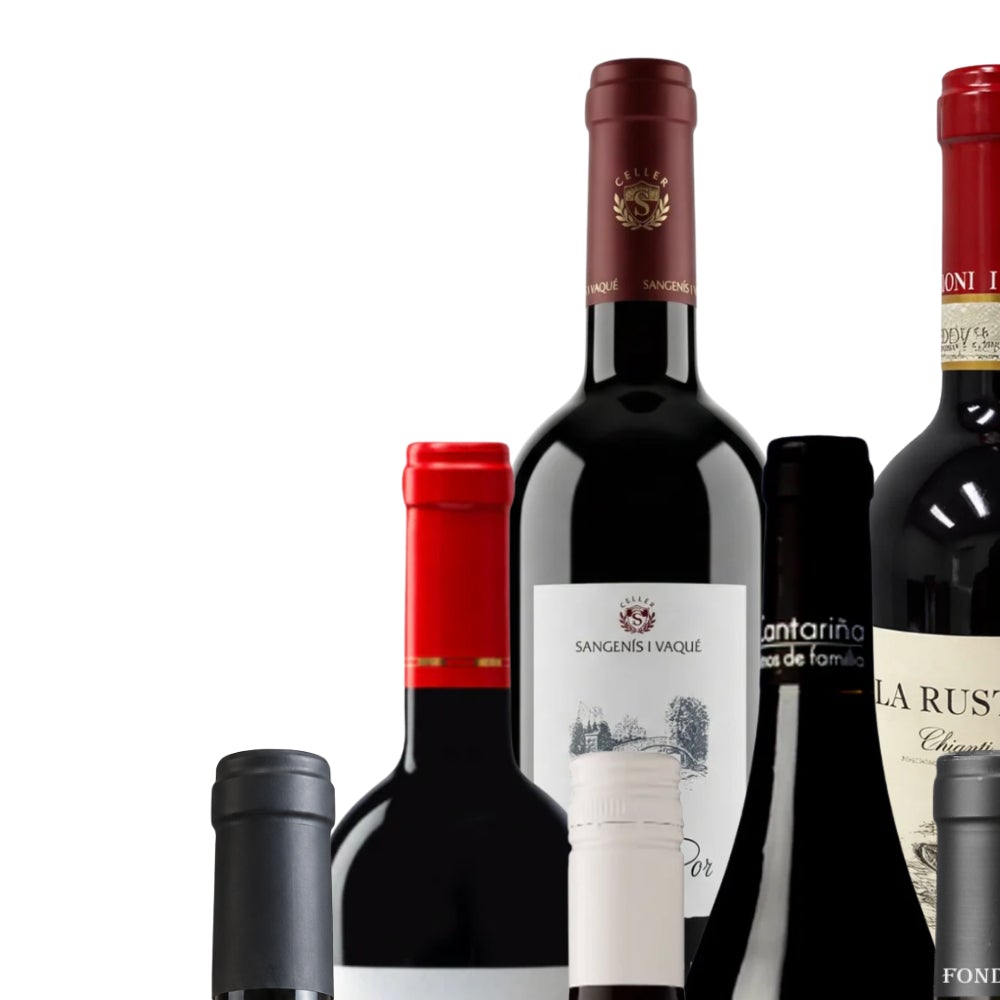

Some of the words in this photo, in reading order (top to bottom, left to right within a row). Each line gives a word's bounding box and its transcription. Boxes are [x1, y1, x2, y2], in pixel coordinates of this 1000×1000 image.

[614, 167, 669, 188] CELLER
[590, 277, 619, 294] VAQUÉ
[643, 280, 689, 293] SANGENÍS
[942, 271, 975, 292] ONI
[990, 271, 997, 290] I
[619, 596, 655, 608] CELLER
[760, 614, 864, 642] antariña
[575, 639, 644, 653] SANGENÍS
[655, 639, 702, 654] VAQUÉ
[783, 645, 806, 667] de
[876, 679, 911, 710] LA
[919, 727, 993, 752] Chianti
